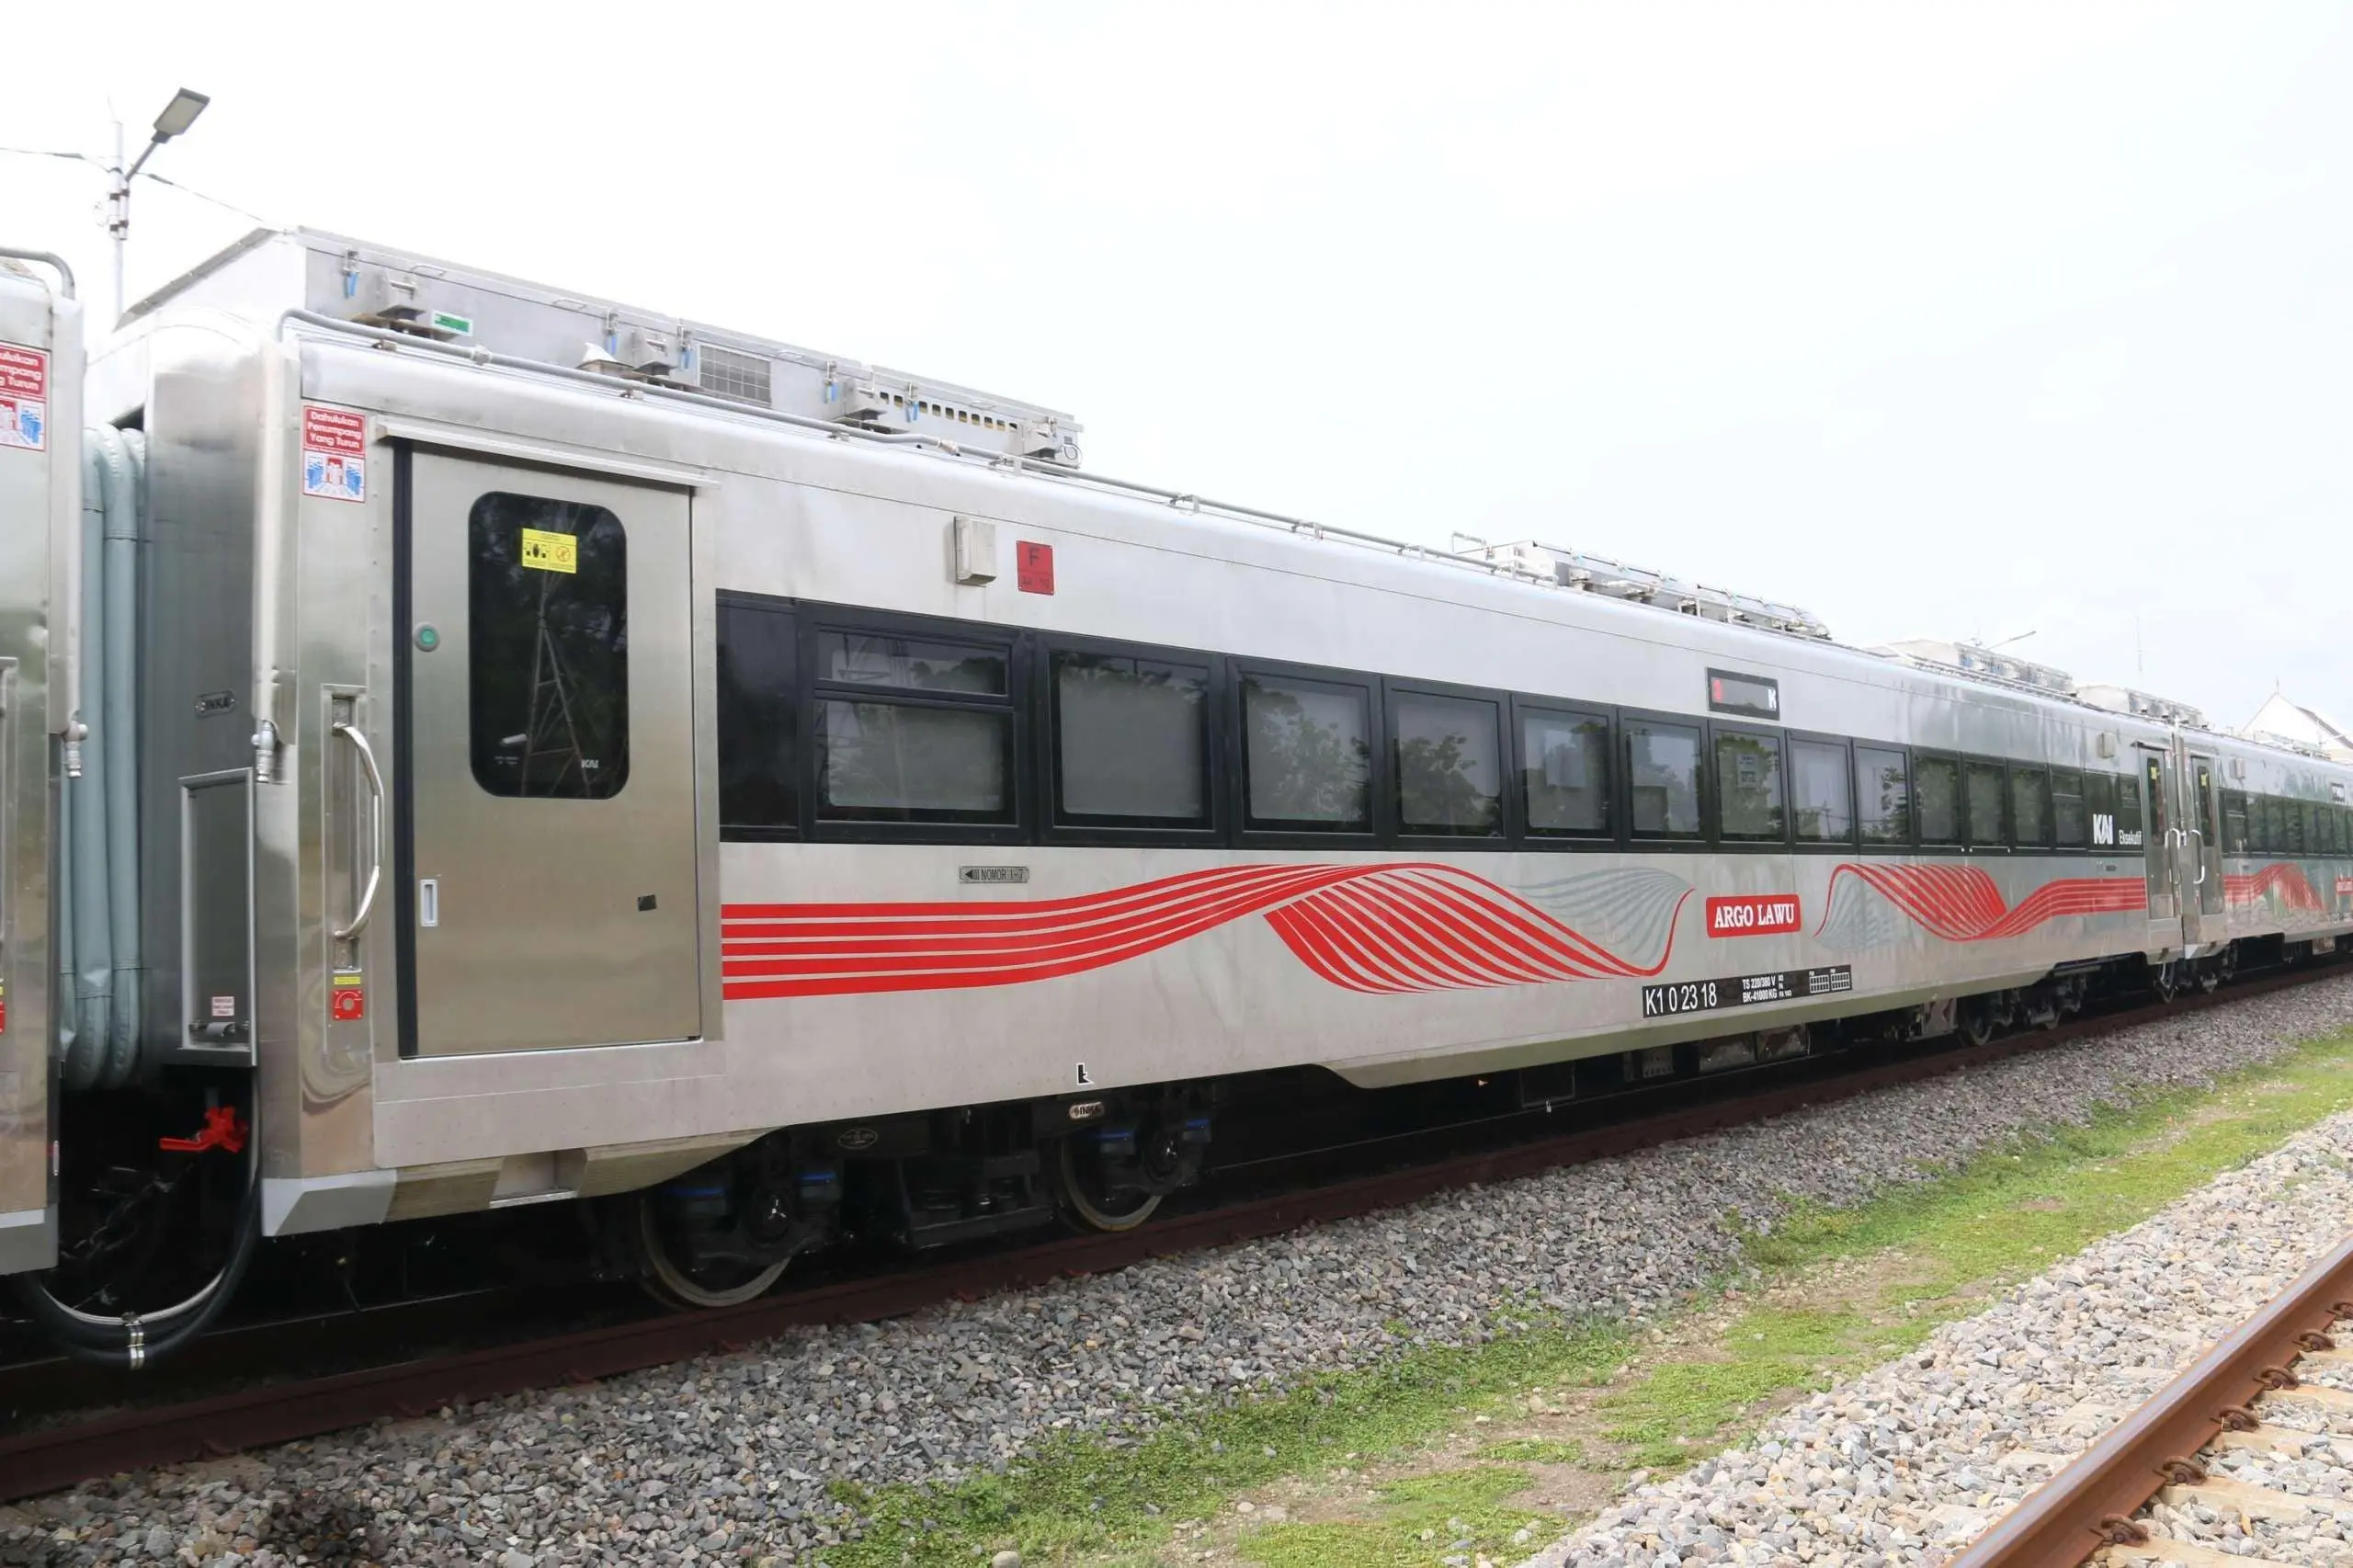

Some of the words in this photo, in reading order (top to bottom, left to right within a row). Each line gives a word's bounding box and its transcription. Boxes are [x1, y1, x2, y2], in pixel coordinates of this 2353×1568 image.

[0, 350, 39, 367] ulukan
[7, 375, 40, 392] Turun
[310, 411, 359, 427] Dahulukan
[307, 421, 362, 440] Penumpang
[310, 432, 335, 447] Yang
[335, 436, 360, 449] Turun
[580, 759, 599, 769] KAI
[2092, 813, 2114, 846] KAI
[981, 868, 1007, 881] NOMOR
[1714, 904, 1754, 928] ARGO
[1756, 903, 1795, 926] LAWU
[1742, 979, 1751, 990] TS
